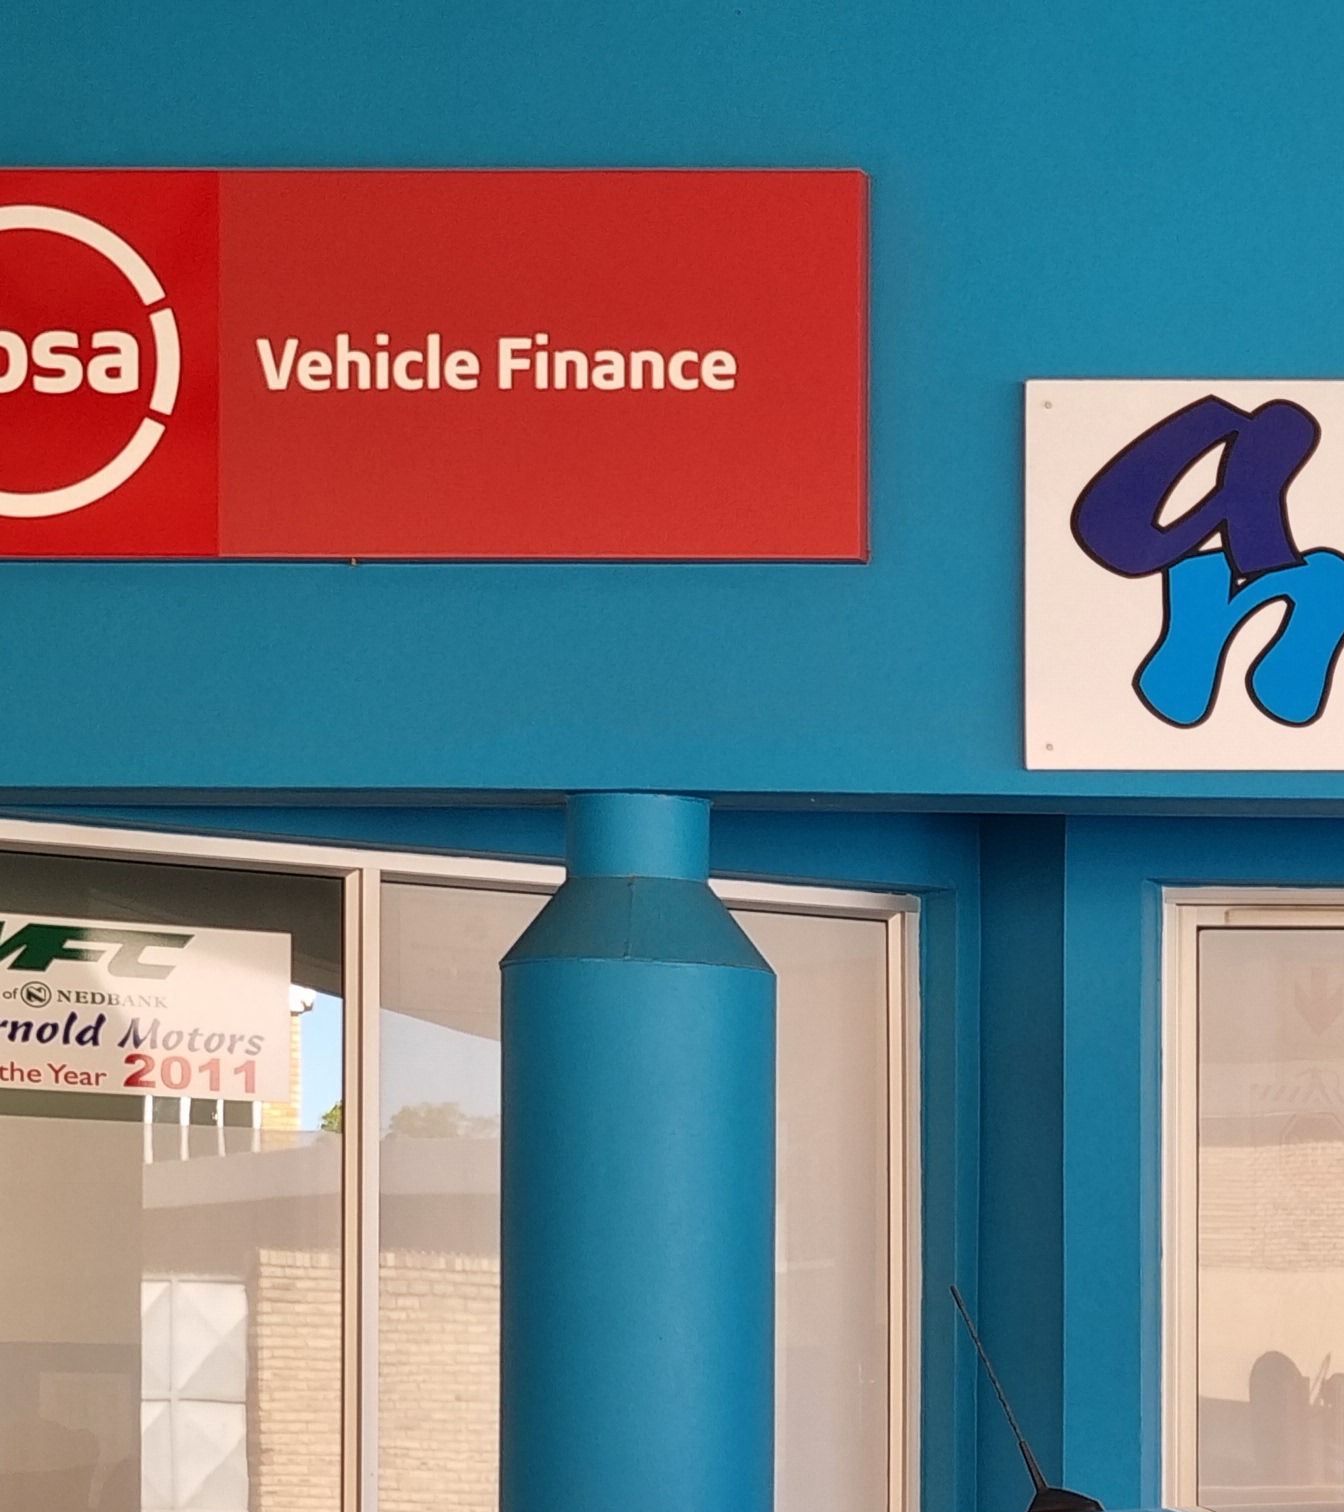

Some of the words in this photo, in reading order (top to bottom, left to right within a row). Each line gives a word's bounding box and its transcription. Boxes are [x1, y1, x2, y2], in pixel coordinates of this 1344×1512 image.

[256, 334, 481, 391] Vehicle
[498, 334, 738, 391] Finance
[0, 921, 195, 980] FC
[2, 987, 19, 1000] of
[56, 989, 168, 1009] NEDBANK
[117, 1017, 265, 1056] Motors
[46, 1063, 108, 1087] Year
[123, 1054, 256, 1094] 2011
